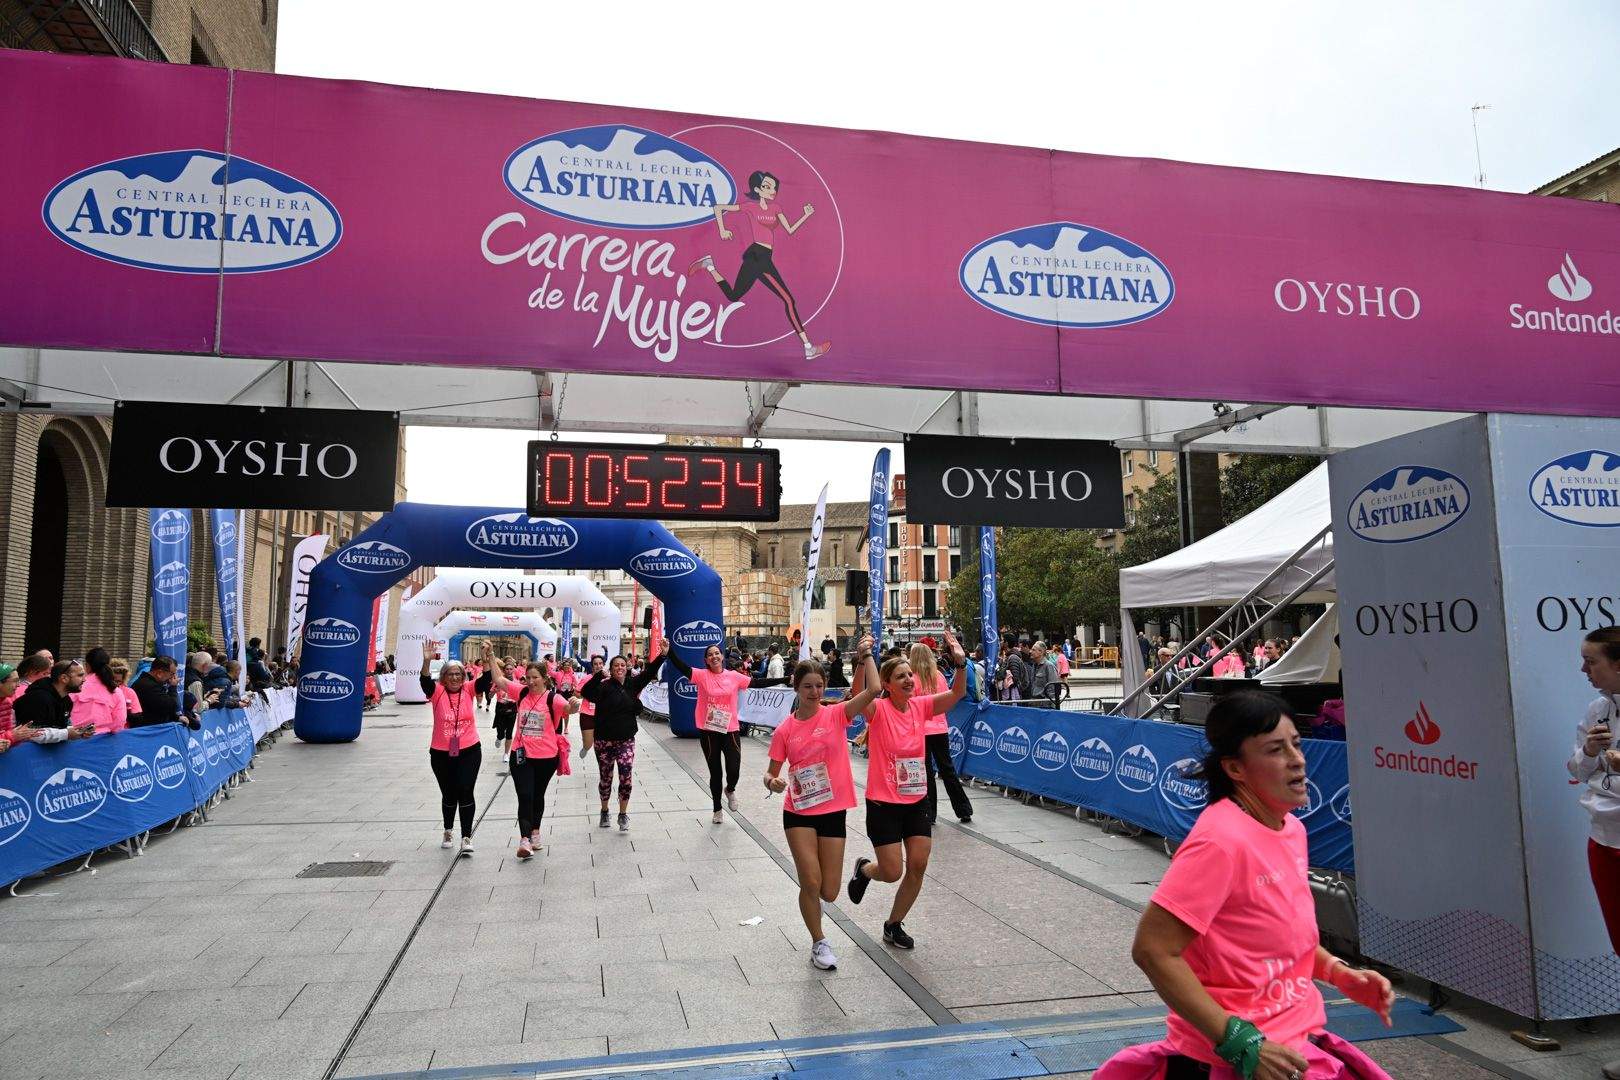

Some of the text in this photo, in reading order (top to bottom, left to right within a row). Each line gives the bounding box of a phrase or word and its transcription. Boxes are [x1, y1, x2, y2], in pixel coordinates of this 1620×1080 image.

[560, 155, 712, 178] CENTRAL LECHERA
[522, 155, 718, 208] ASTURIANA
[117, 187, 312, 212] CENTRAL LECHERA
[65, 187, 320, 248] ASTURIANA
[480, 211, 675, 277] Carrera
[1010, 254, 1152, 274] CENTRAL LECHERA
[976, 254, 1159, 304] ASTURIANA
[1275, 278, 1421, 320] OYSHO
[528, 272, 746, 363] de la Mujer
[159, 436, 358, 480] OYSHO
[941, 466, 1093, 501] OYSHO
[1560, 476, 1604, 485] CENTRAL
[1371, 483, 1455, 506] CENTRAL LECHERA
[1355, 494, 1461, 530] ASTURIANA
[474, 525, 570, 546] ASTURIANA
[341, 551, 405, 567] ASTURIANA
[635, 560, 693, 571] ASTURIANA
[469, 581, 557, 599] OYSHO
[1355, 598, 1479, 636] OYSHO
[306, 626, 356, 641] ASTURIANA
[301, 681, 350, 694] ASTURIANA
[747, 690, 785, 709] OYSHO
[1072, 750, 1110, 772] ASTURIANA
[1374, 746, 1479, 780] Santander
[116, 773, 152, 794] ASTURIANA
[43, 786, 104, 815] ASTURIANA
